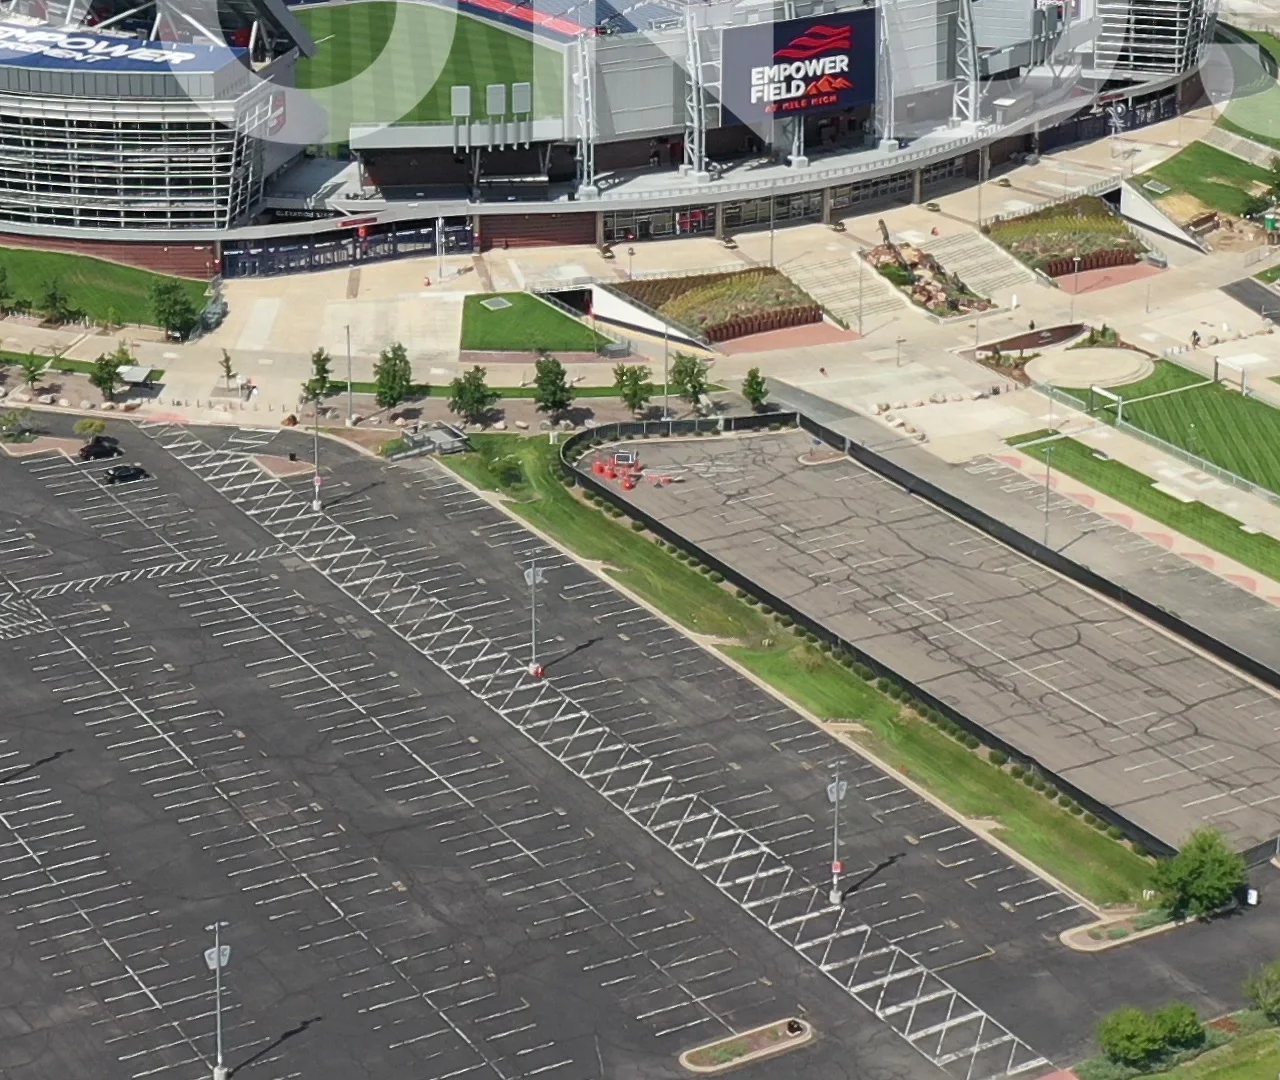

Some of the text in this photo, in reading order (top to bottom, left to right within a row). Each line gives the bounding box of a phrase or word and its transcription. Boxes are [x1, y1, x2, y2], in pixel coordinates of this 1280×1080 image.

[750, 54, 849, 86] EMPOWER
[750, 79, 806, 104] FIELD
[764, 95, 837, 113] AT MILE HIGH
